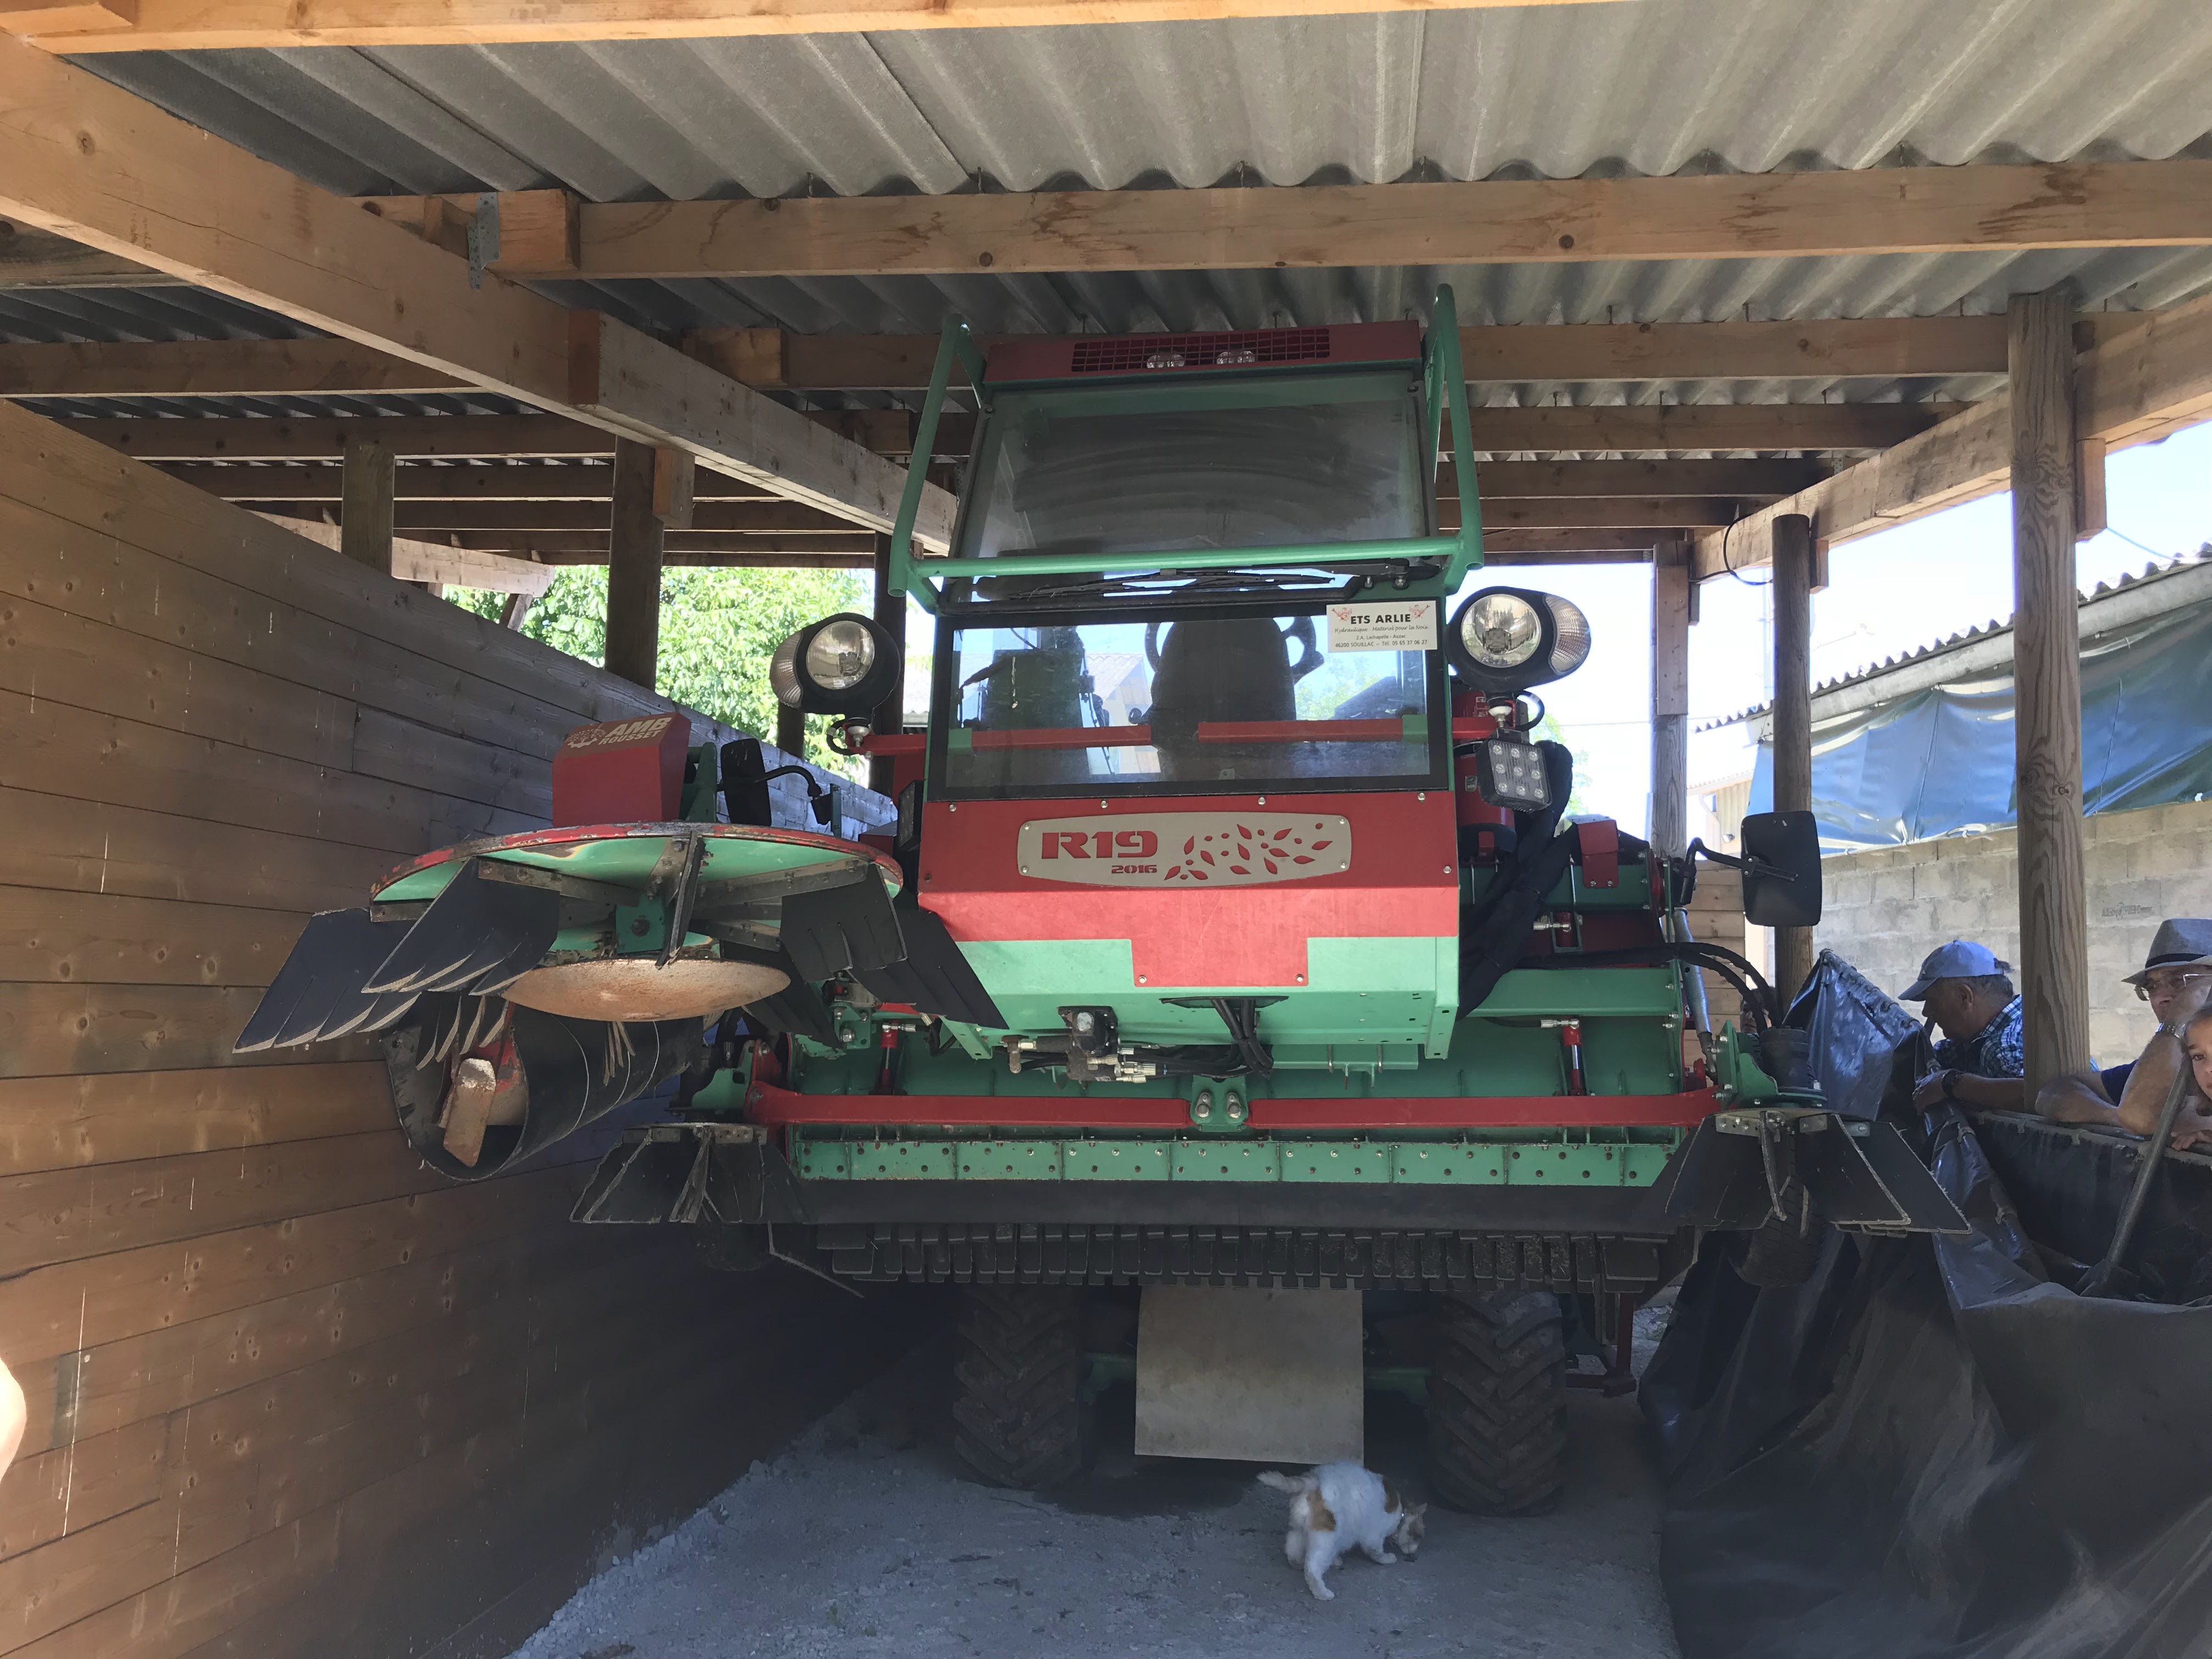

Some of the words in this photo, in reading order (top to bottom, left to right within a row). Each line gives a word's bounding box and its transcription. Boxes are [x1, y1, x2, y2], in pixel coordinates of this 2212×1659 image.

[1351, 616, 1370, 624] ETS
[1375, 614, 1411, 623] ARLIE
[606, 717, 672, 737] AMB
[597, 730, 662, 745] ROUSSET
[1041, 830, 1158, 860] R19
[1110, 864, 1158, 874] 2016
